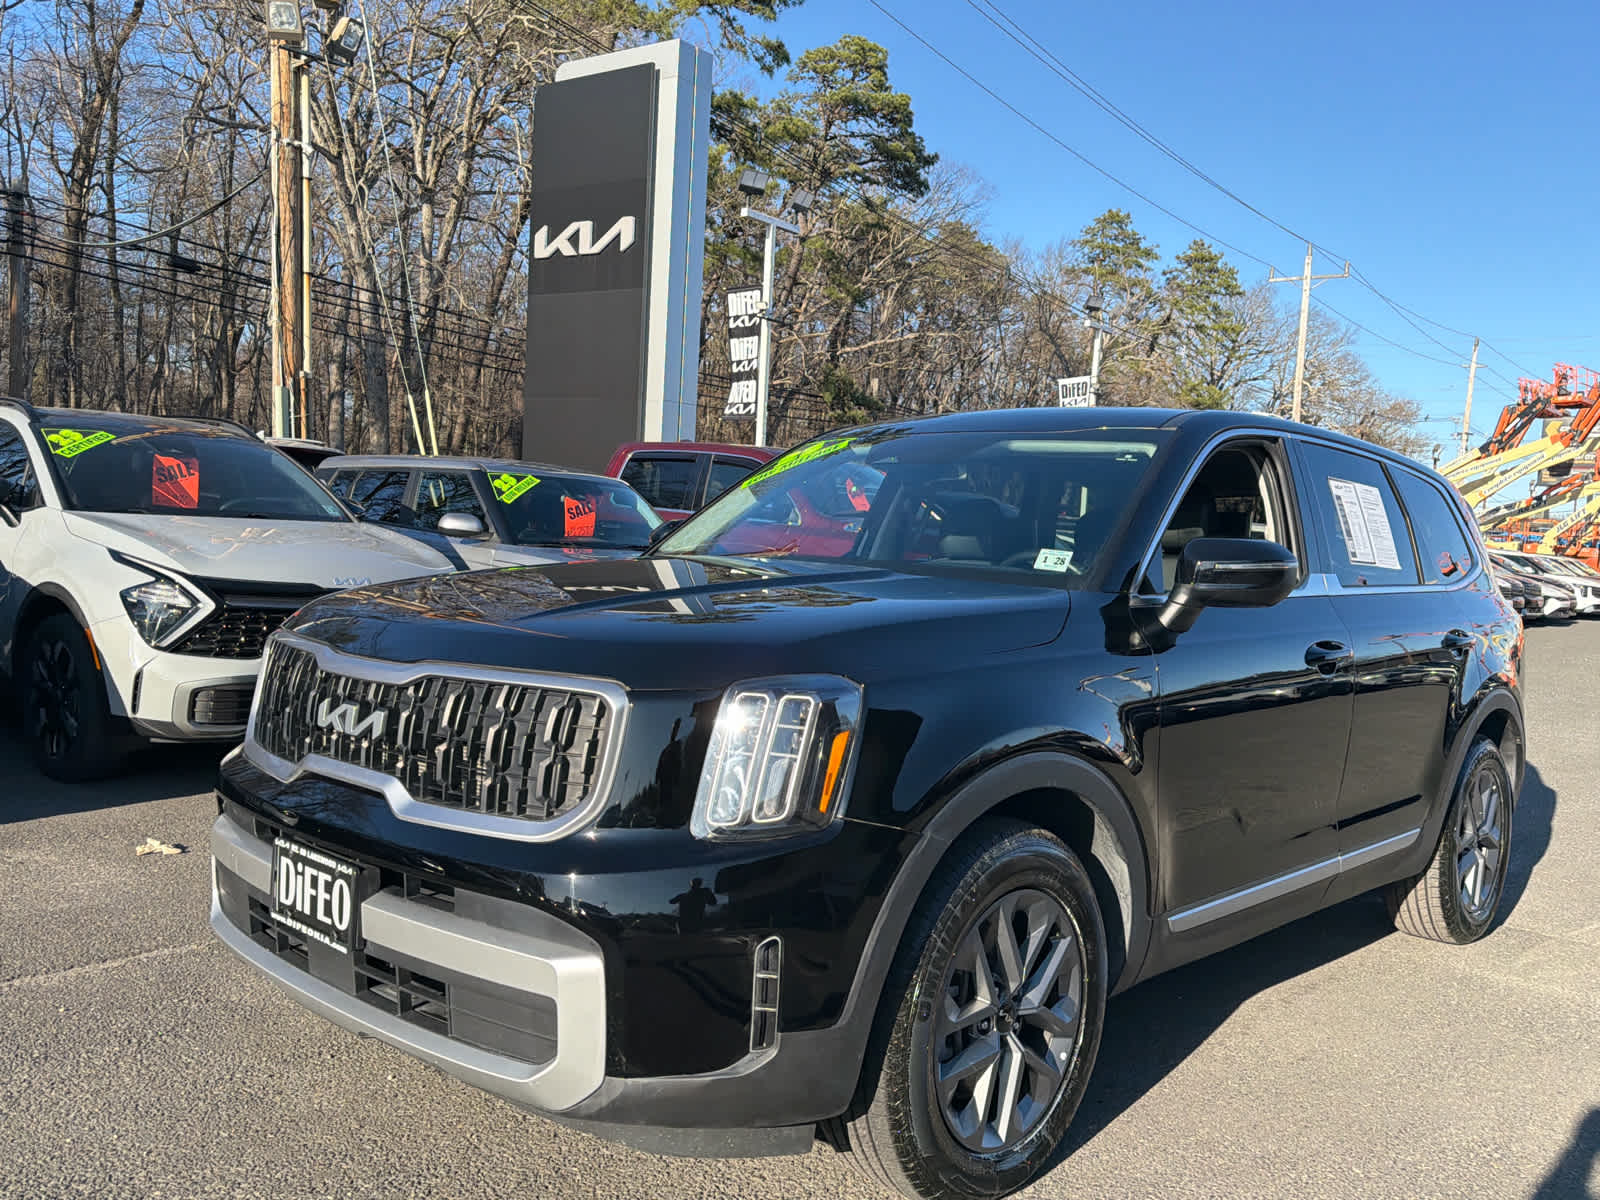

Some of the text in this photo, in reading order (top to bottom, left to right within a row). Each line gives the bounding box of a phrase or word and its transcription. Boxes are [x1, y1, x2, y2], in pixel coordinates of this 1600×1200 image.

[534, 216, 635, 259] KIA
[729, 315, 760, 328] KIA
[732, 359, 758, 372] KIA
[1061, 381, 1088, 399] DiFEO
[724, 403, 756, 415] KIA
[60, 433, 110, 455] CERTIFIED
[156, 462, 196, 482] SALE
[316, 698, 389, 740] KIA
[280, 855, 351, 931] DiFEO
